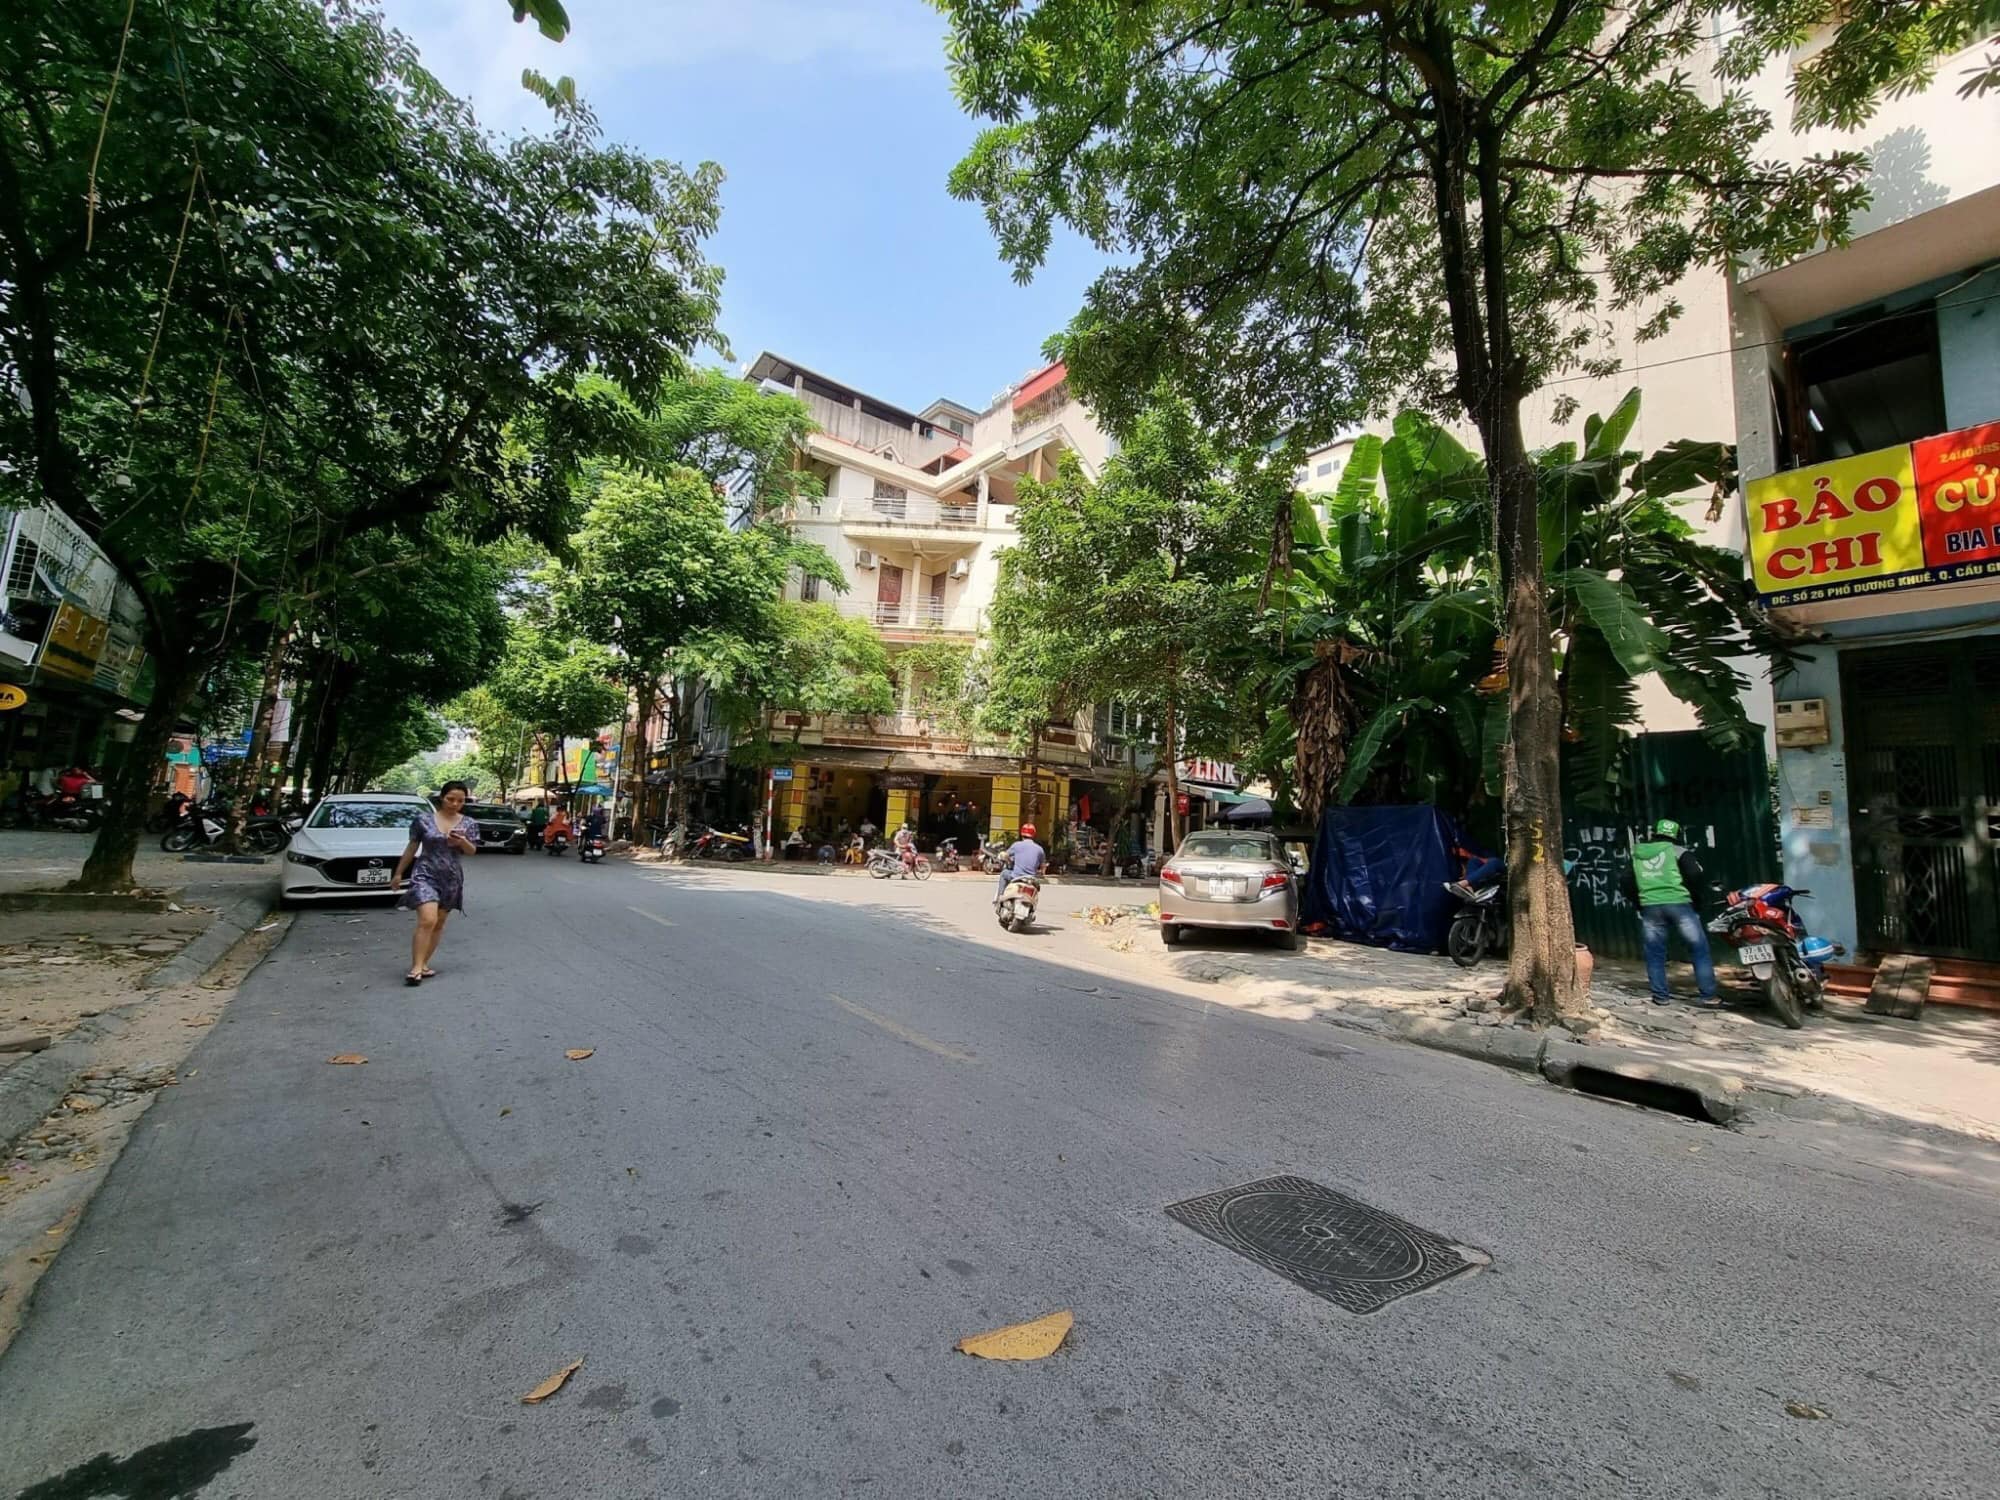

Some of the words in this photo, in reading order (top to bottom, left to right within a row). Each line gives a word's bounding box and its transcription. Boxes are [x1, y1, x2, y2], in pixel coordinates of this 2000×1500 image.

[1759, 476, 1903, 534] BẢO
[1765, 531, 1883, 580] CHI
[1945, 528, 1988, 554] BIA
